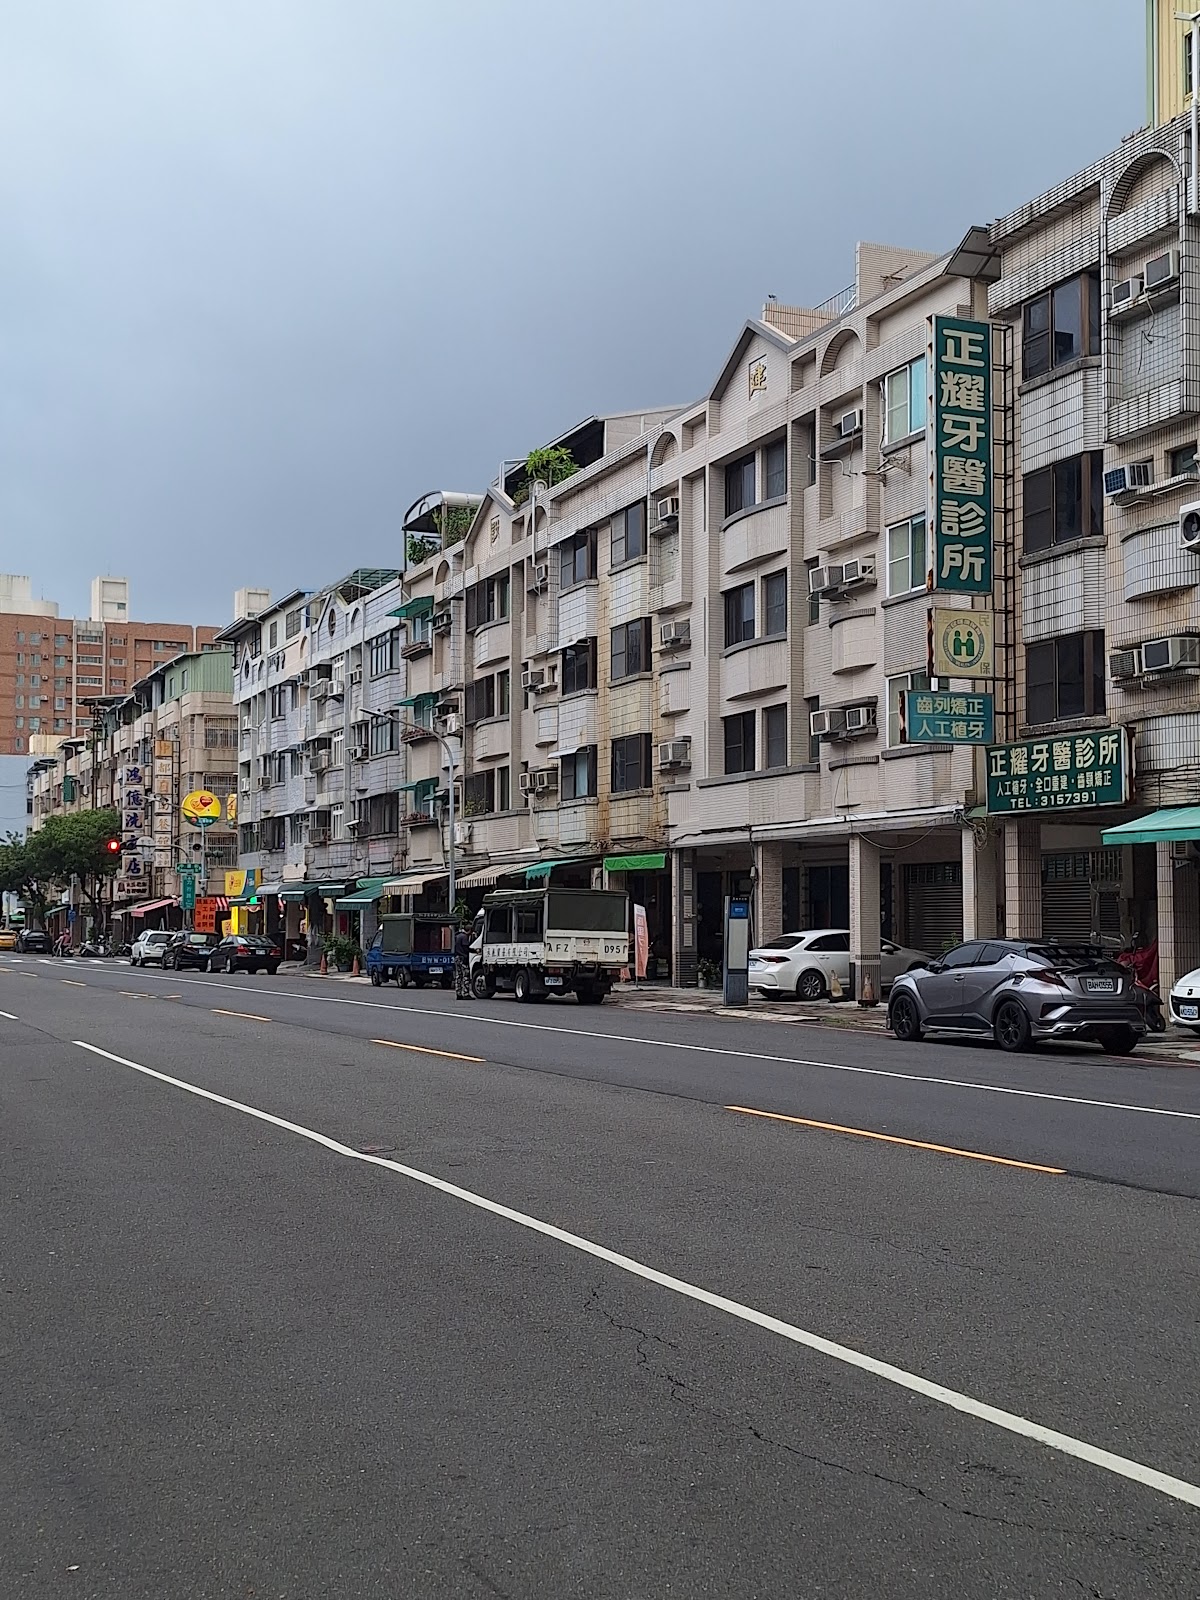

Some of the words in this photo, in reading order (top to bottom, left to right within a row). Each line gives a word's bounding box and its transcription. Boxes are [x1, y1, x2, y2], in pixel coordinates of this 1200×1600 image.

[939, 328, 986, 582] 正耀牙醫診所
[916, 696, 984, 716] 齒列矯正
[917, 719, 985, 739] 人工植牙
[990, 733, 1119, 777] 正耀牙醫診所
